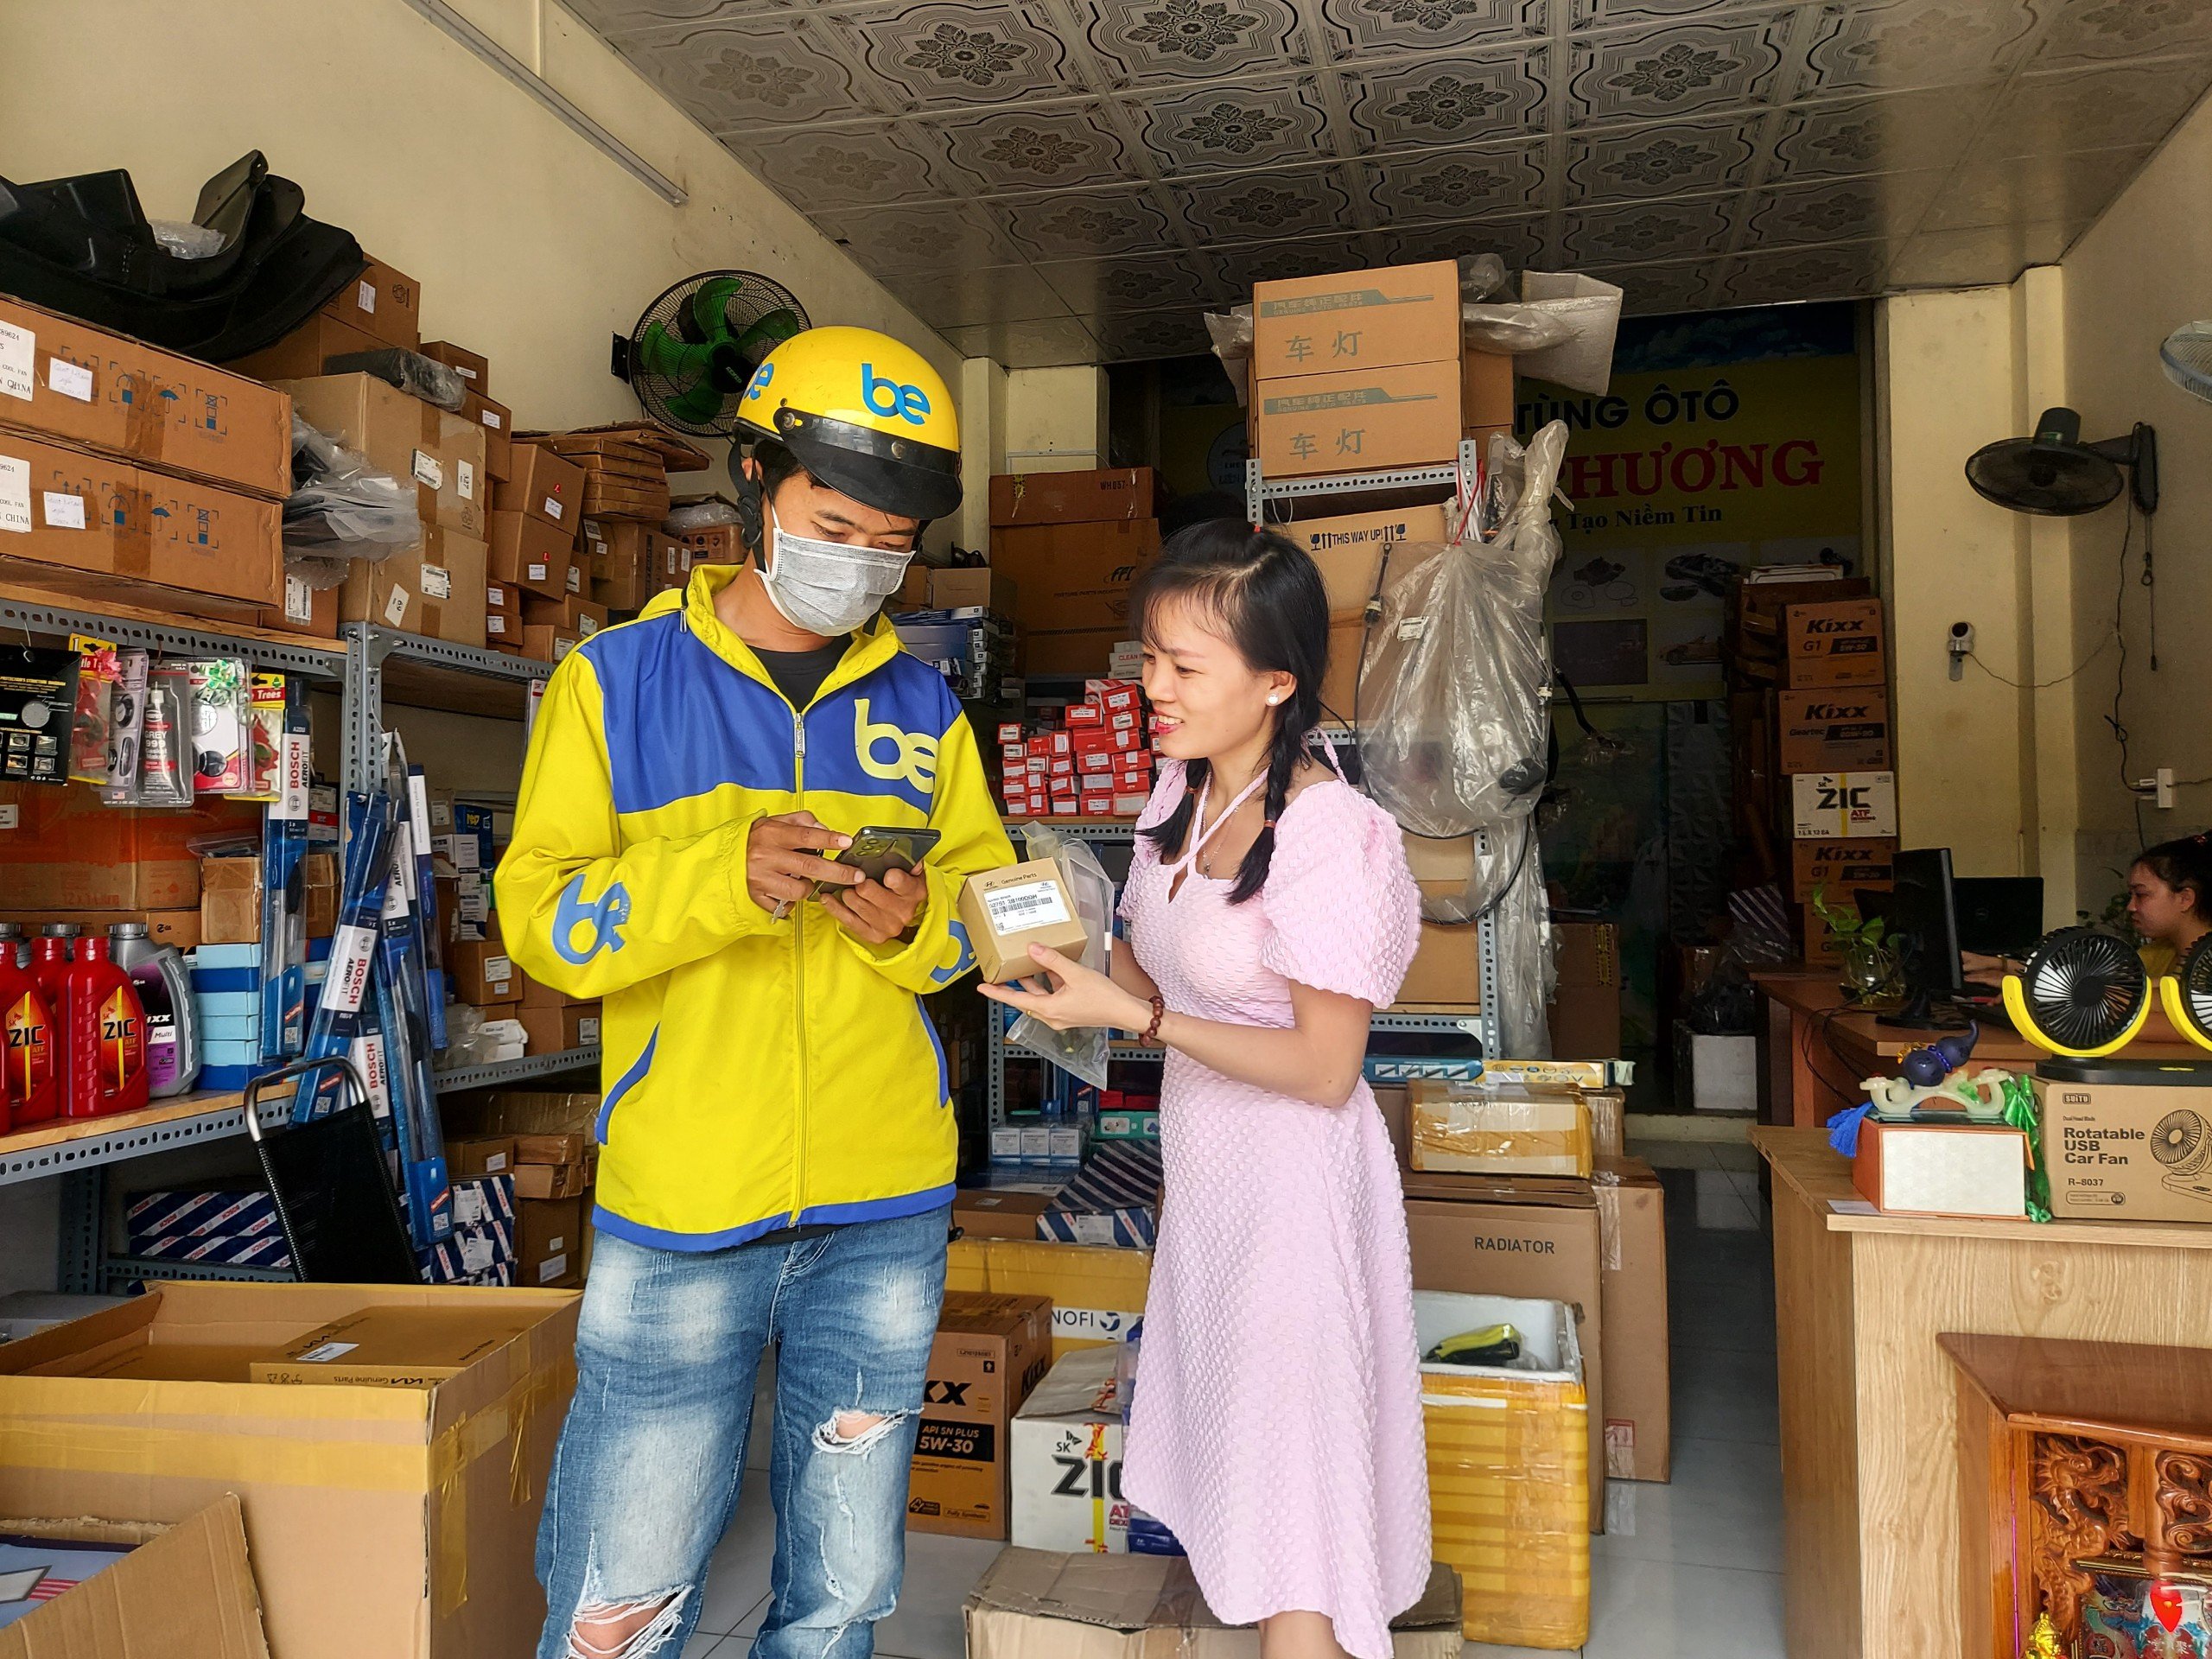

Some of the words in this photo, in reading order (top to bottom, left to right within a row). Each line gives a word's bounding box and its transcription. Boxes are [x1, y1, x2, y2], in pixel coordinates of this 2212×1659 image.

[861, 363, 931, 425] be
[1644, 378, 1739, 425] ÔTÔ
[1557, 438, 1824, 501] HƯƠNG
[5, 513, 29, 524] CHINA
[1567, 512, 1608, 534] Tạo
[1616, 502, 1675, 527] Niềm
[1682, 504, 1722, 524] Tin
[1332, 532, 1350, 545] THIS
[1351, 531, 1370, 543] WAY
[1806, 619, 1864, 633] Kixx
[1802, 639, 1821, 652] G1
[257, 690, 282, 700] Trees
[1805, 703, 1869, 720] Kixx
[146, 740, 166, 748] 999
[854, 698, 940, 794] be
[290, 741, 300, 789] BOSCH
[1816, 787, 1872, 810] ZIC
[1815, 847, 1873, 861] Kixx
[340, 957, 354, 995] AEROFIT
[348, 958, 367, 1005] BOSCH
[147, 1014, 171, 1023] ixx
[9, 1025, 45, 1048] ZIC
[103, 1018, 136, 1041] ZIC
[366, 1043, 378, 1089] BOSCH
[2063, 1127, 2145, 1140] Rotatable
[2064, 1140, 2101, 1152] USB
[2064, 1152, 2094, 1164] Car
[2098, 1153, 2128, 1165] Fan
[1474, 1236, 1554, 1254] RADIATOR
[922, 1426, 938, 1434] API
[955, 1428, 980, 1439] PLUS
[918, 1436, 974, 1453] 5W-30
[1056, 1442, 1071, 1452] SK
